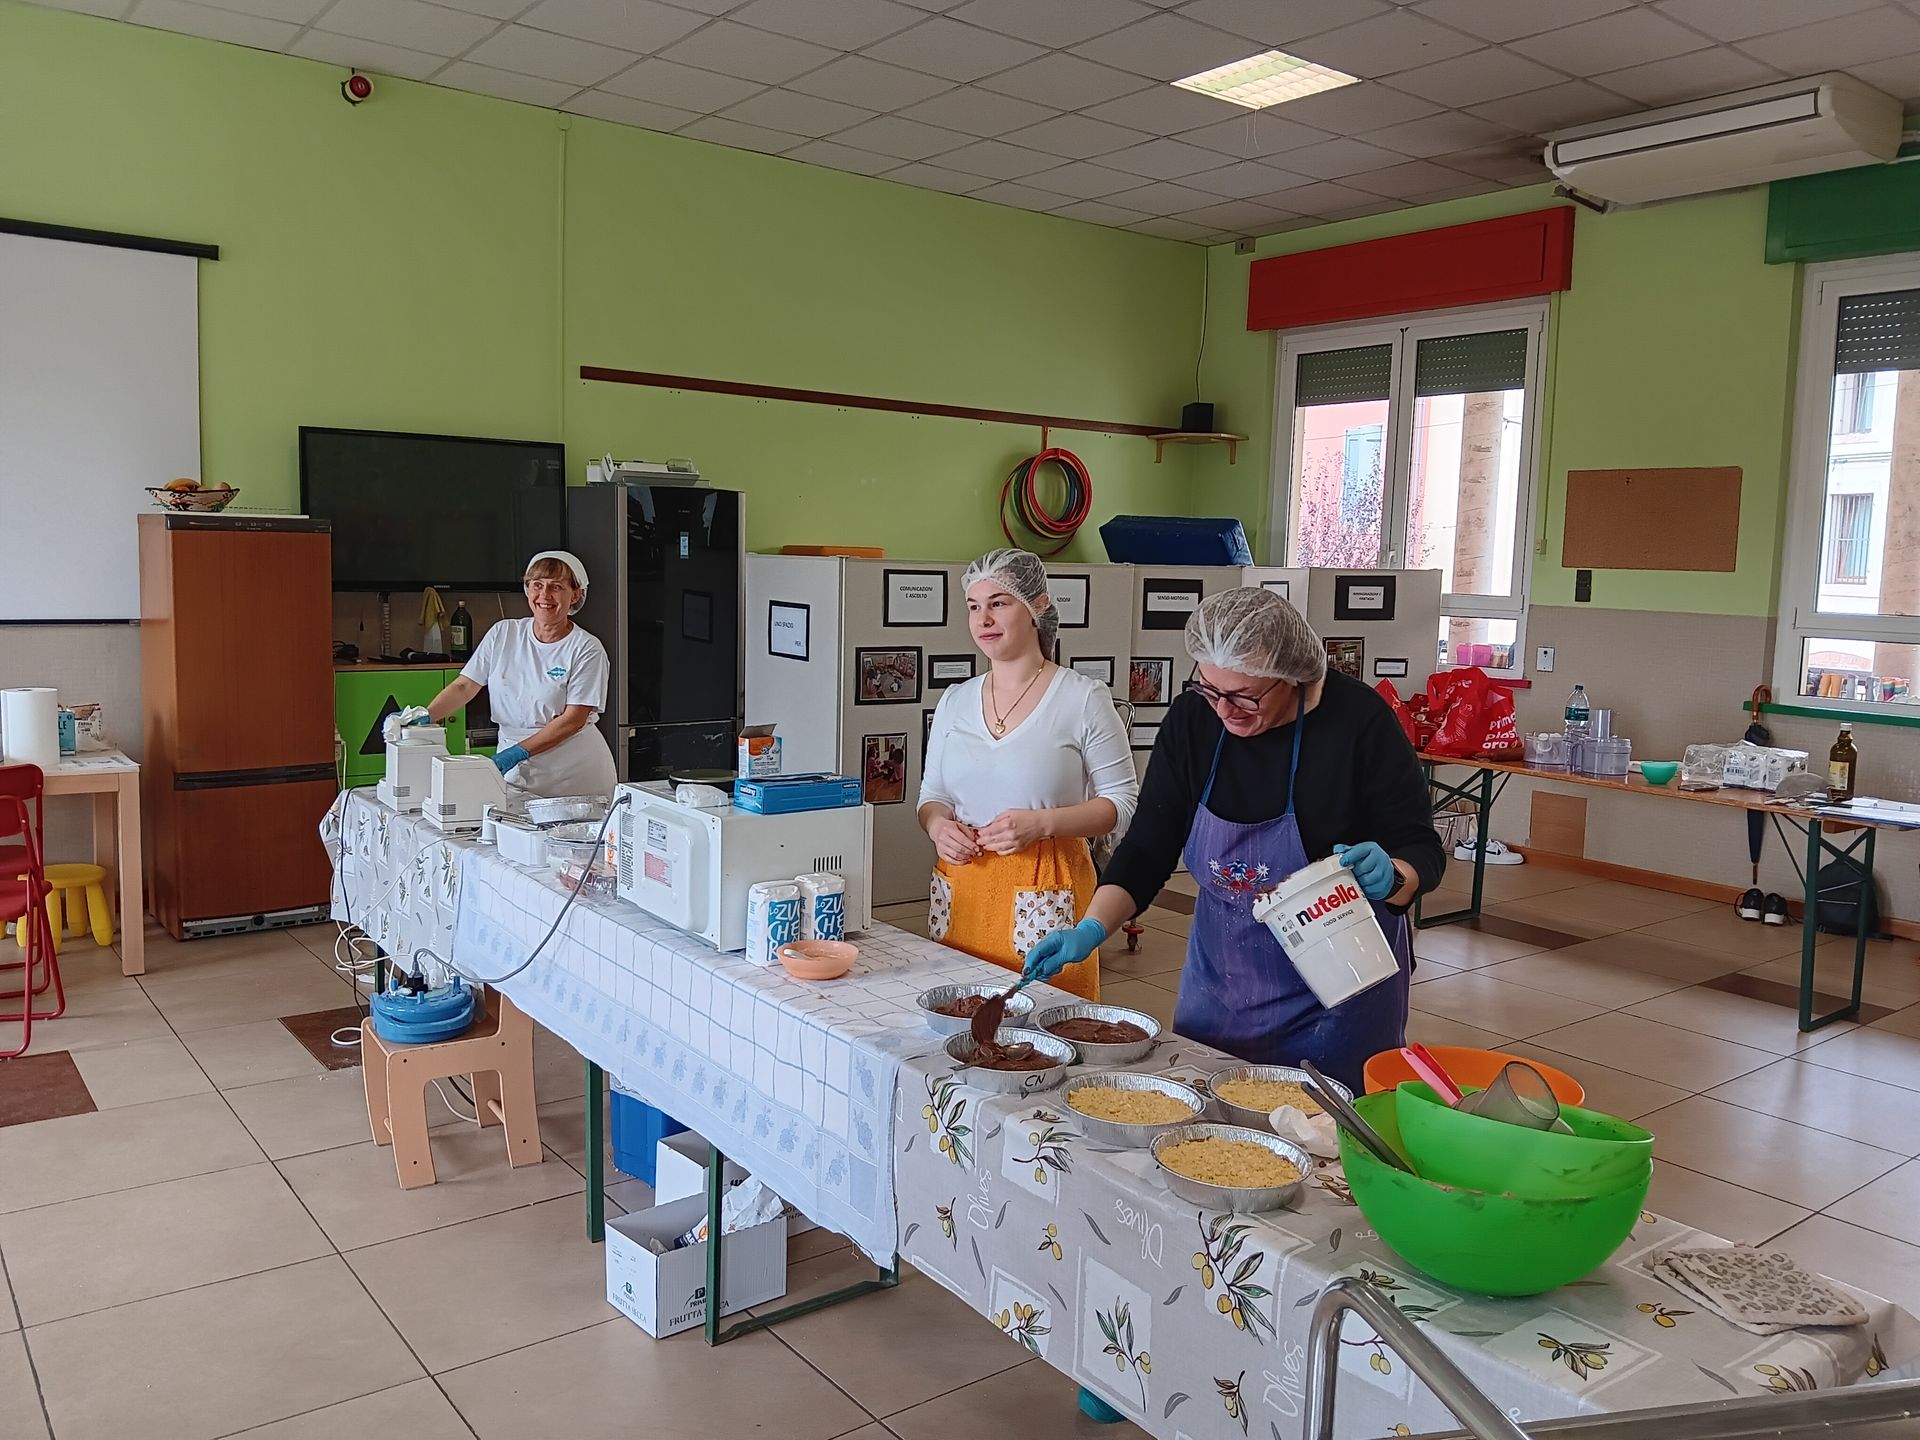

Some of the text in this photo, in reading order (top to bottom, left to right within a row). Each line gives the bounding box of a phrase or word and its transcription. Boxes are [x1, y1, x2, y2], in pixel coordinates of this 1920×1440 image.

[1295, 884, 1360, 927] nutella
[1322, 908, 1354, 928] FOOD SERVICE
[669, 1309, 702, 1327] FRUTTA
